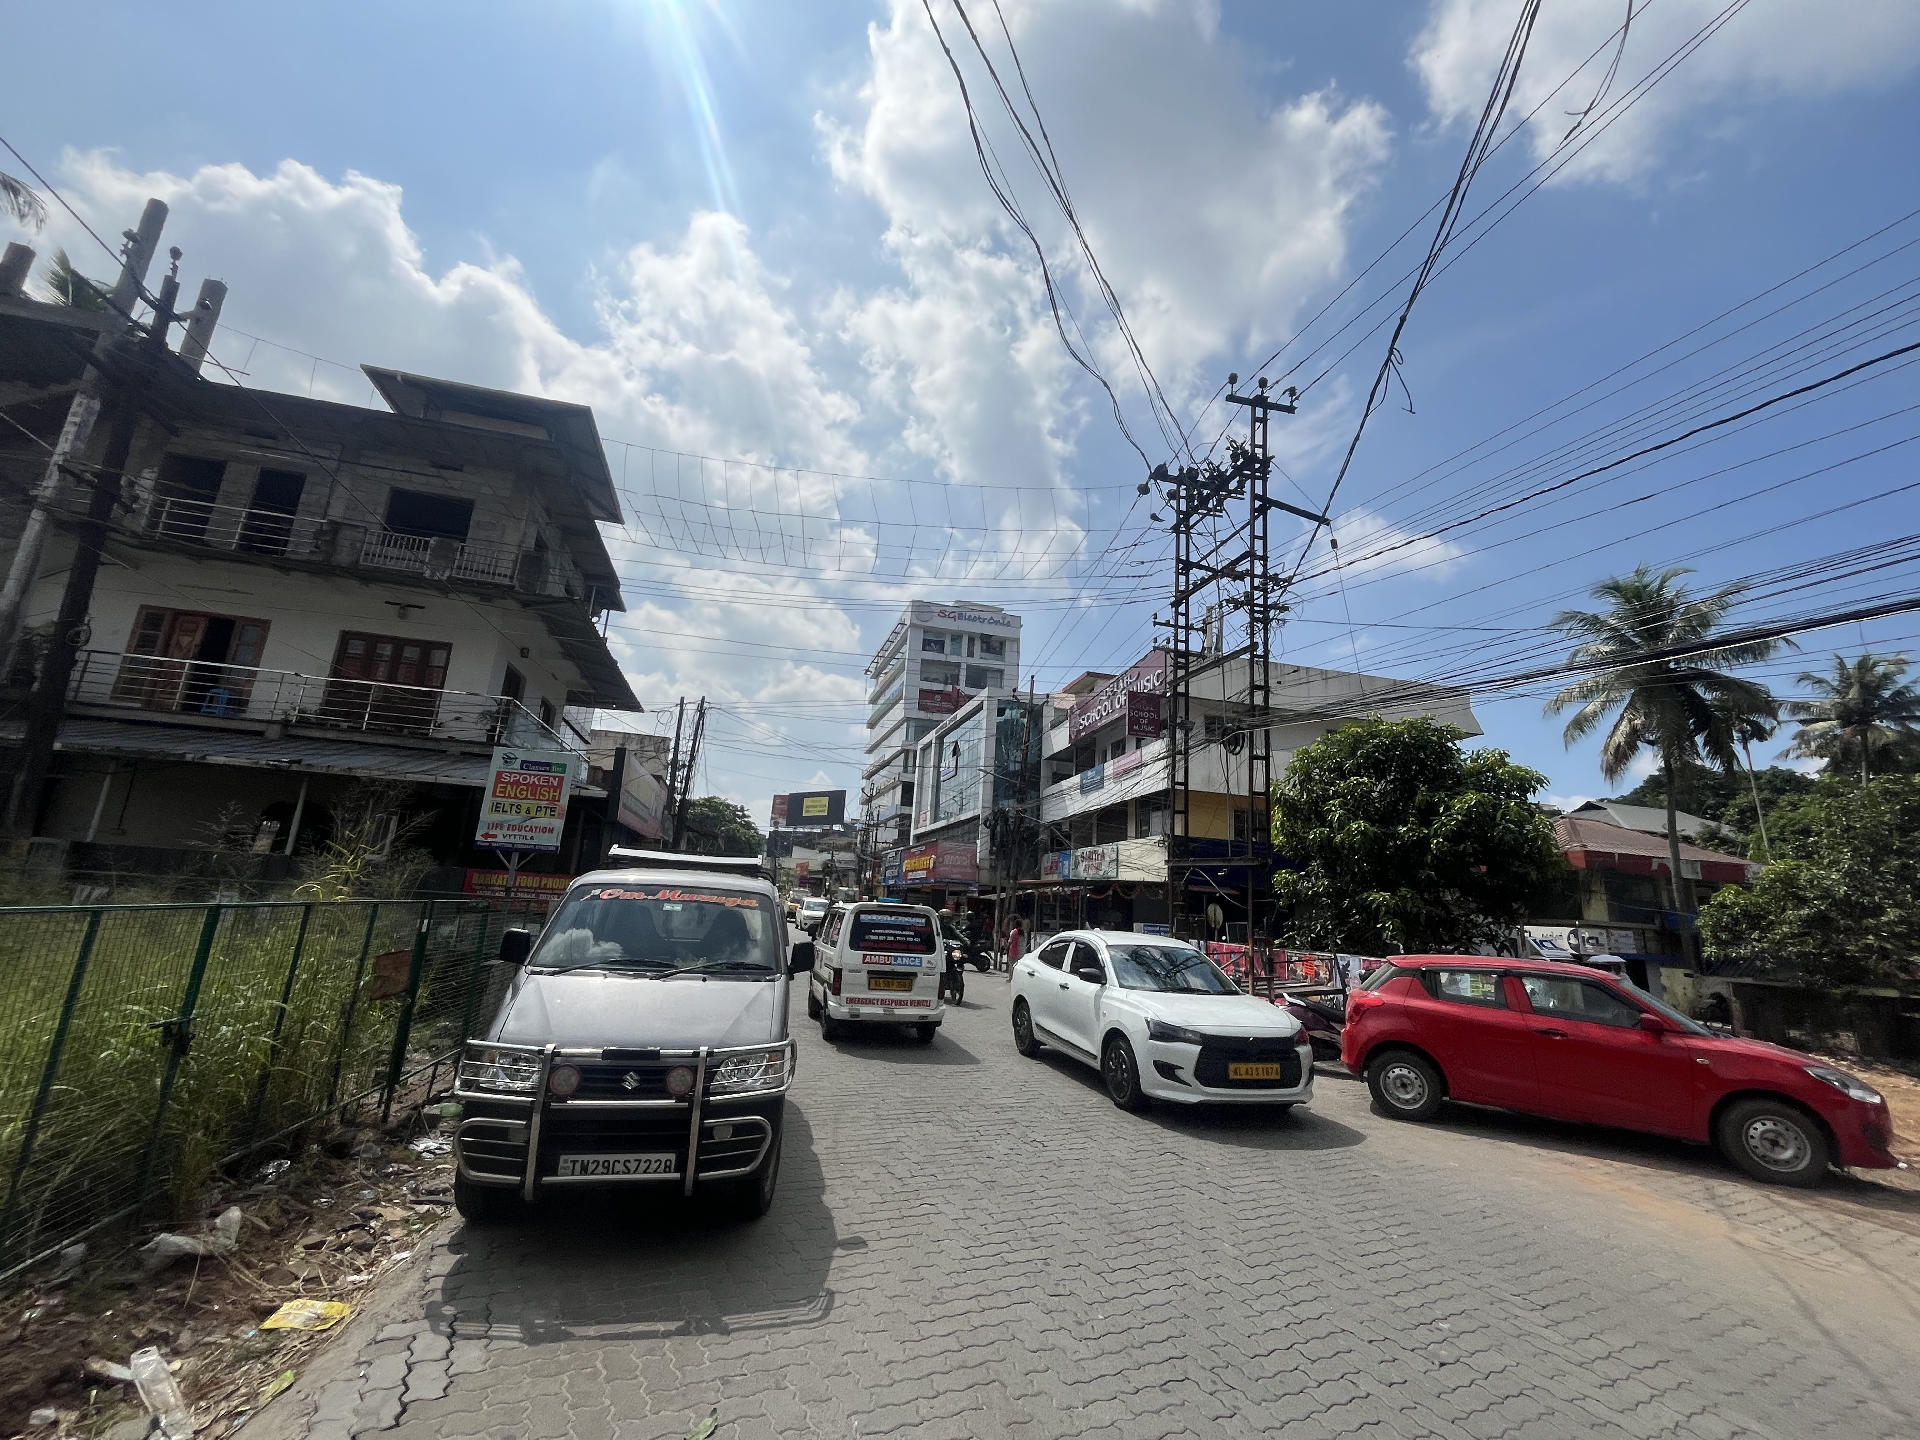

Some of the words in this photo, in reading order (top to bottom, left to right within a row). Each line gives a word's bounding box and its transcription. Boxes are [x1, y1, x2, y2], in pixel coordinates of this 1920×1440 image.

[1079, 700, 1113, 730] SCHOOL
[1129, 710, 1159, 720] SCHOOL
[501, 772, 559, 787] SPOKEN
[495, 783, 561, 801] ENGLISH
[490, 801, 522, 815] IELTS
[524, 805, 531, 815] &
[535, 805, 558, 817] PTE
[506, 823, 555, 835] EDUCATION
[502, 832, 536, 841] VYTTILA
[515, 875, 540, 888] FOOD
[864, 954, 922, 967] AMBULANCE
